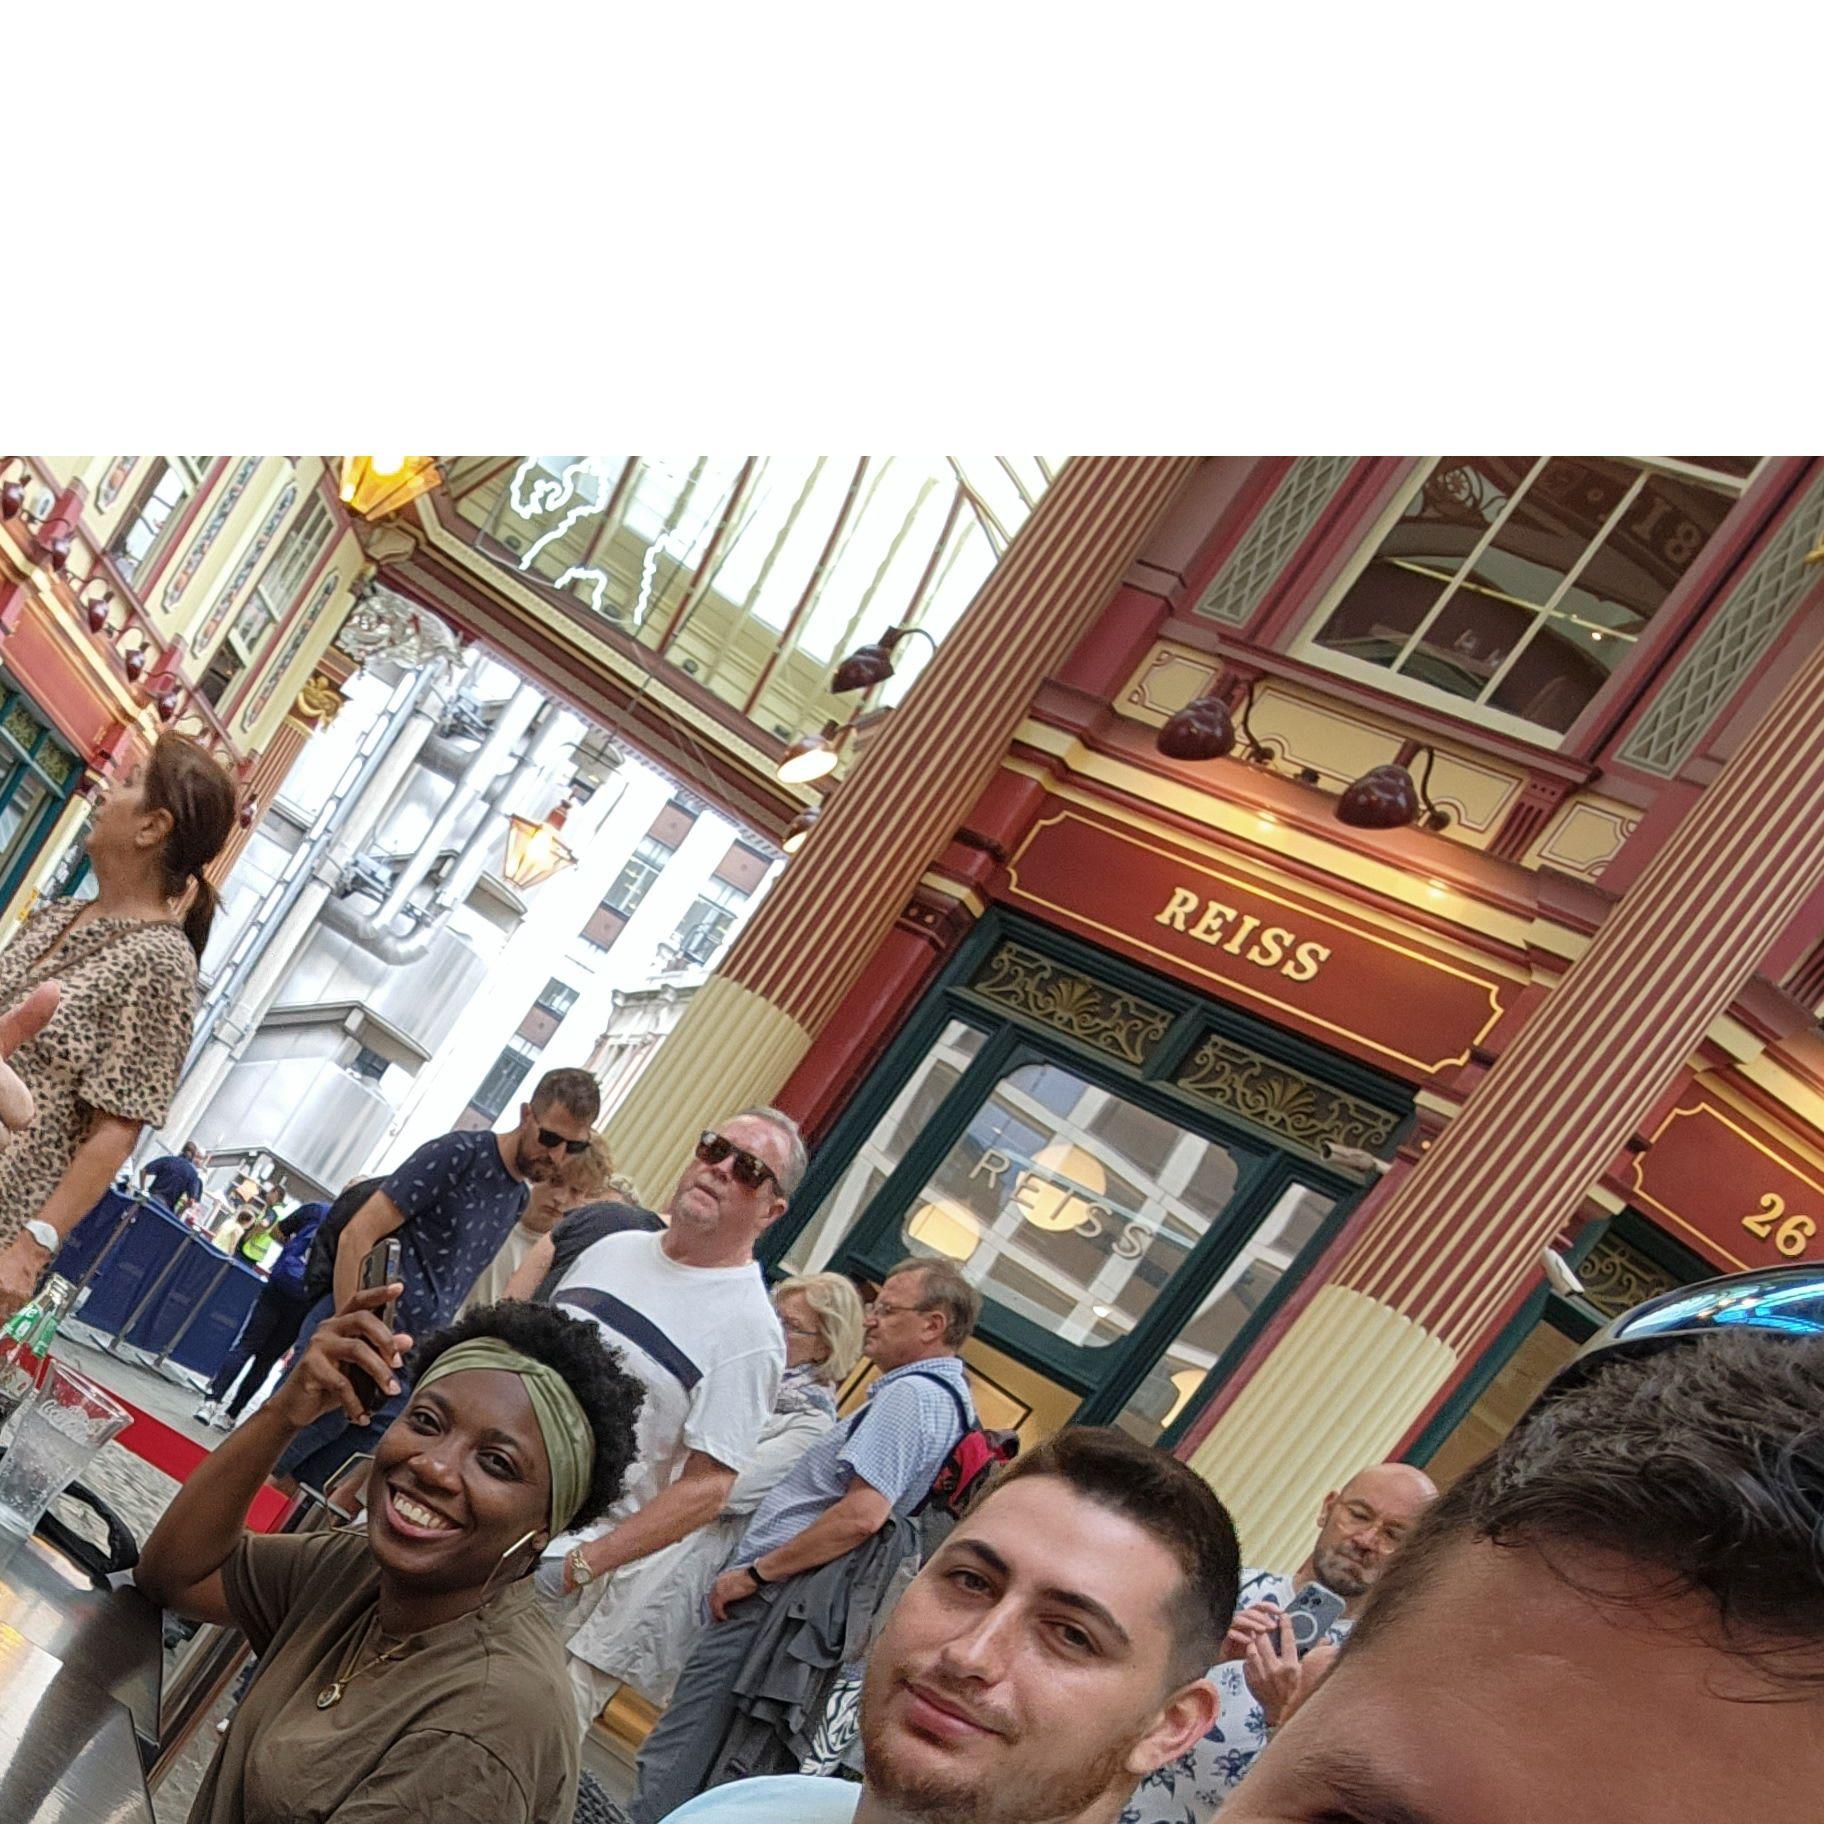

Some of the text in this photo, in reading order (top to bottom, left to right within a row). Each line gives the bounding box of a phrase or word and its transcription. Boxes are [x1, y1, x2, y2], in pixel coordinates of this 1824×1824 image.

[1155, 886, 1331, 982] REISS
[968, 1147, 1154, 1258] REISS
[1741, 1192, 1817, 1257] 26
